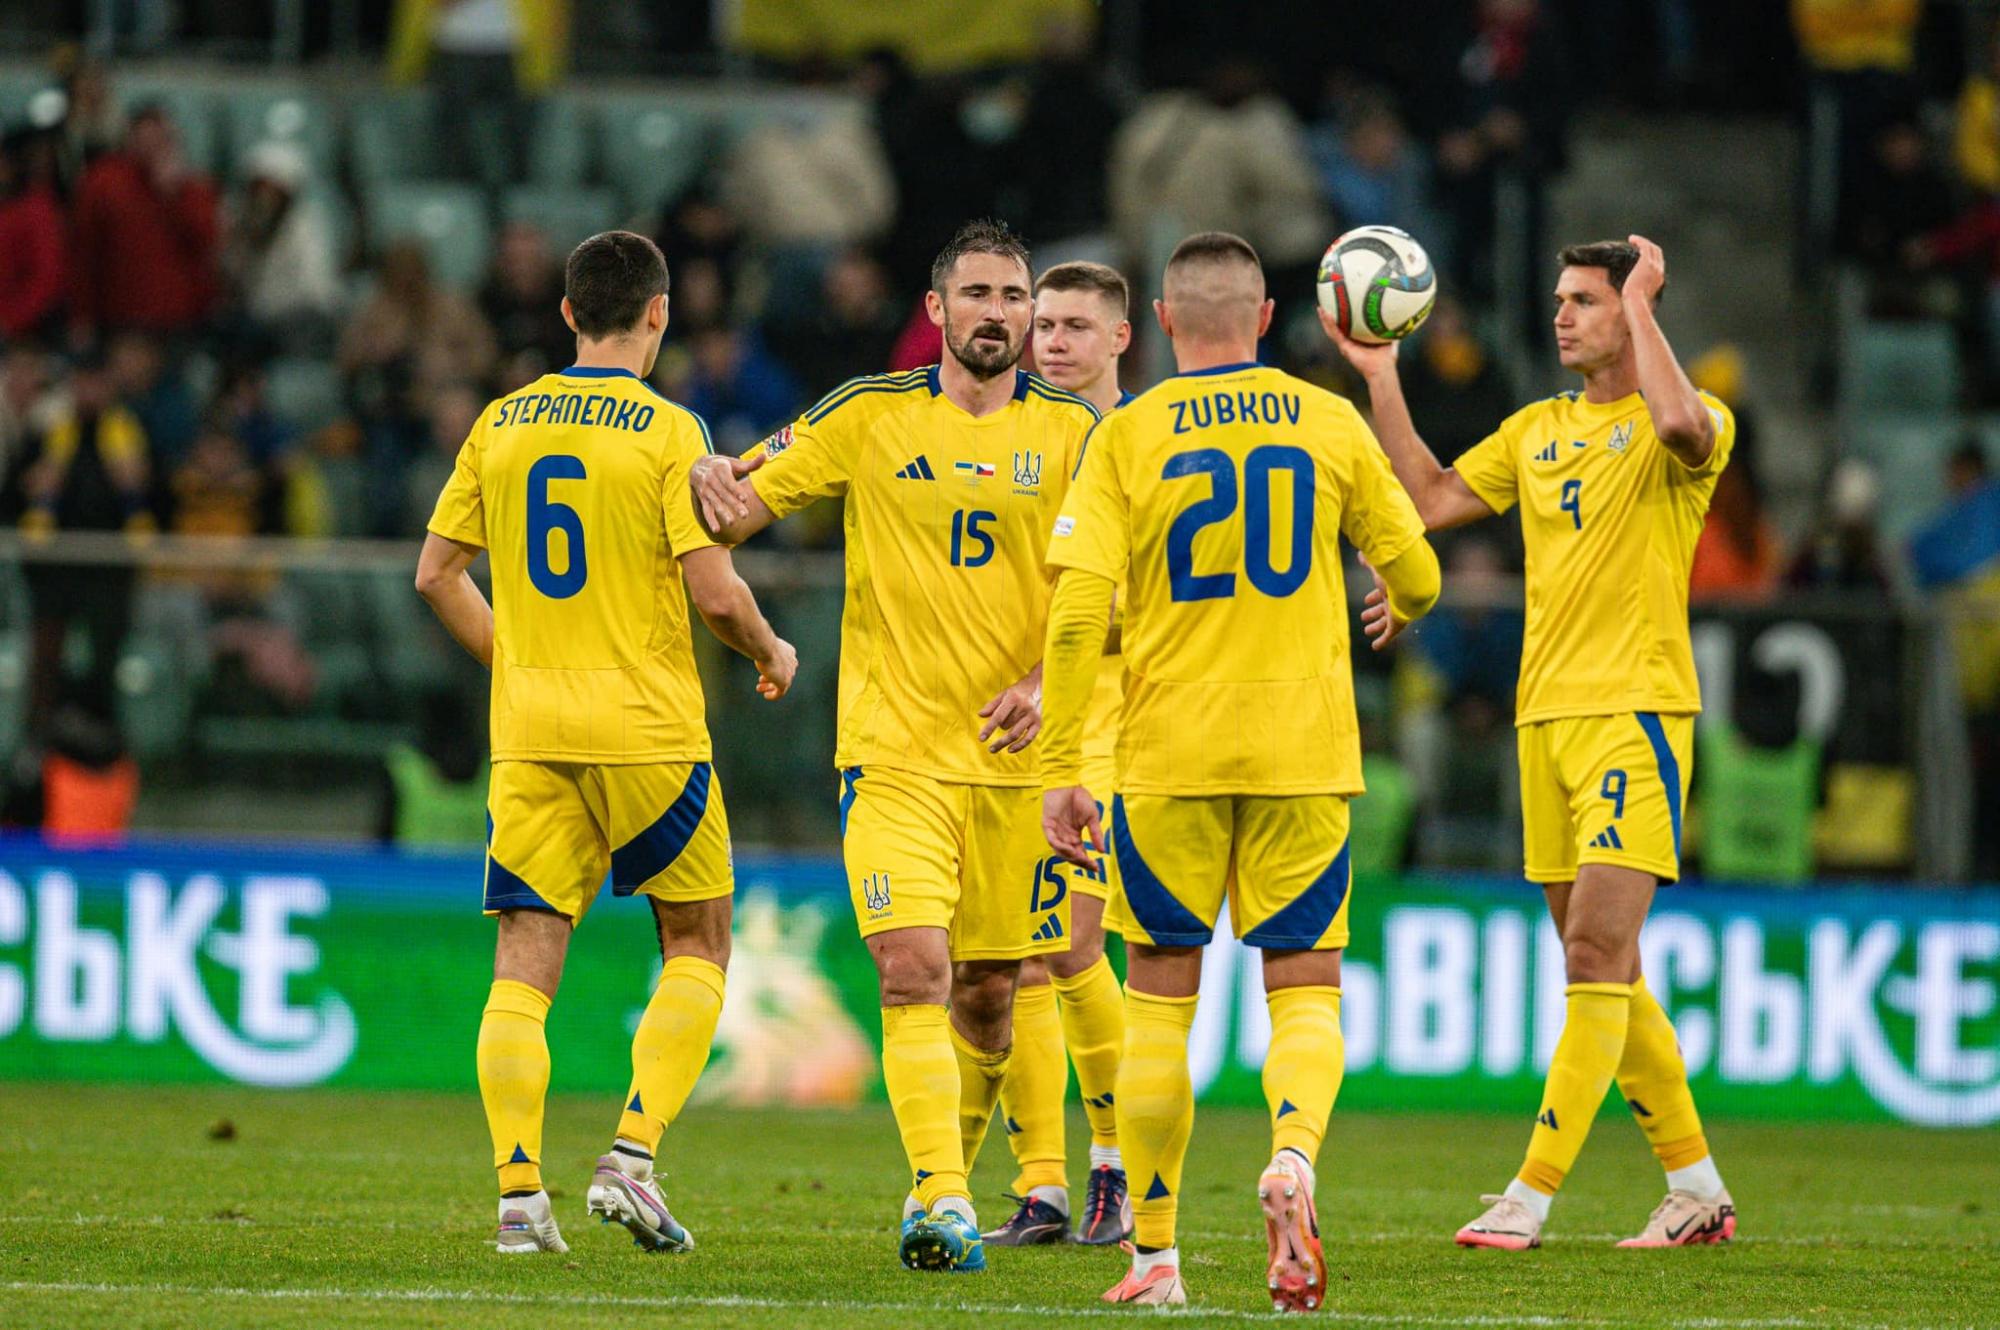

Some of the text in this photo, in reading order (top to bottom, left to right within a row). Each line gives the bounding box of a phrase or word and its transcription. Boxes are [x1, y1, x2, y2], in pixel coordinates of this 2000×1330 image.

[493, 394, 655, 433] STEPANENKO
[1168, 392, 1301, 435] ZUBKOV
[527, 455, 588, 599] 6
[1161, 445, 1316, 603] 20
[1560, 480, 1583, 530] 9
[950, 509, 998, 568] 15
[1601, 769, 1627, 819] 9
[1030, 855, 1067, 914] 15
